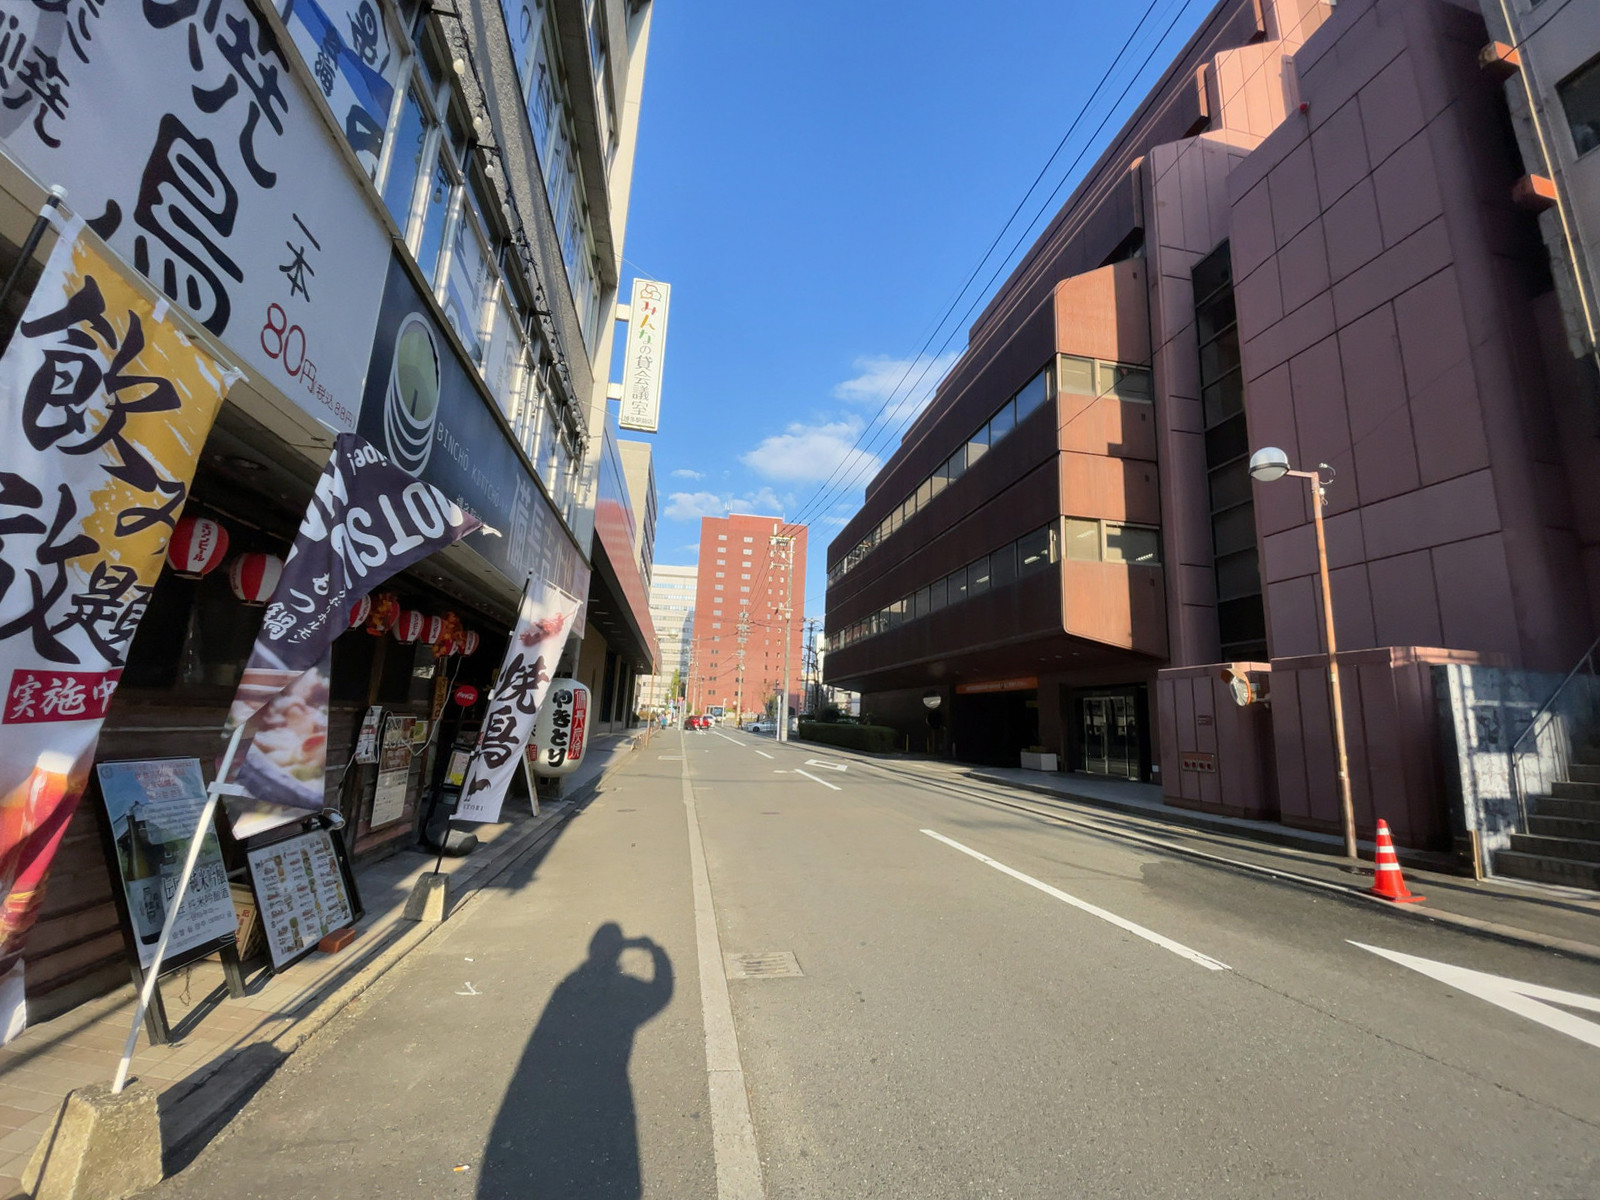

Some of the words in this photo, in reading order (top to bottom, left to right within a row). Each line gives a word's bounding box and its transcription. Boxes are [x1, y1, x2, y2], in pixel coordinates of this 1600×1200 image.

[83, 0, 288, 336] 焼鳥
[279, 212, 321, 303] 一本
[630, 301, 657, 417] みんなの貸会議室
[264, 572, 330, 641] もつ鍋
[471, 652, 550, 770] 焼鳥
[547, 688, 573, 768] やきとり
